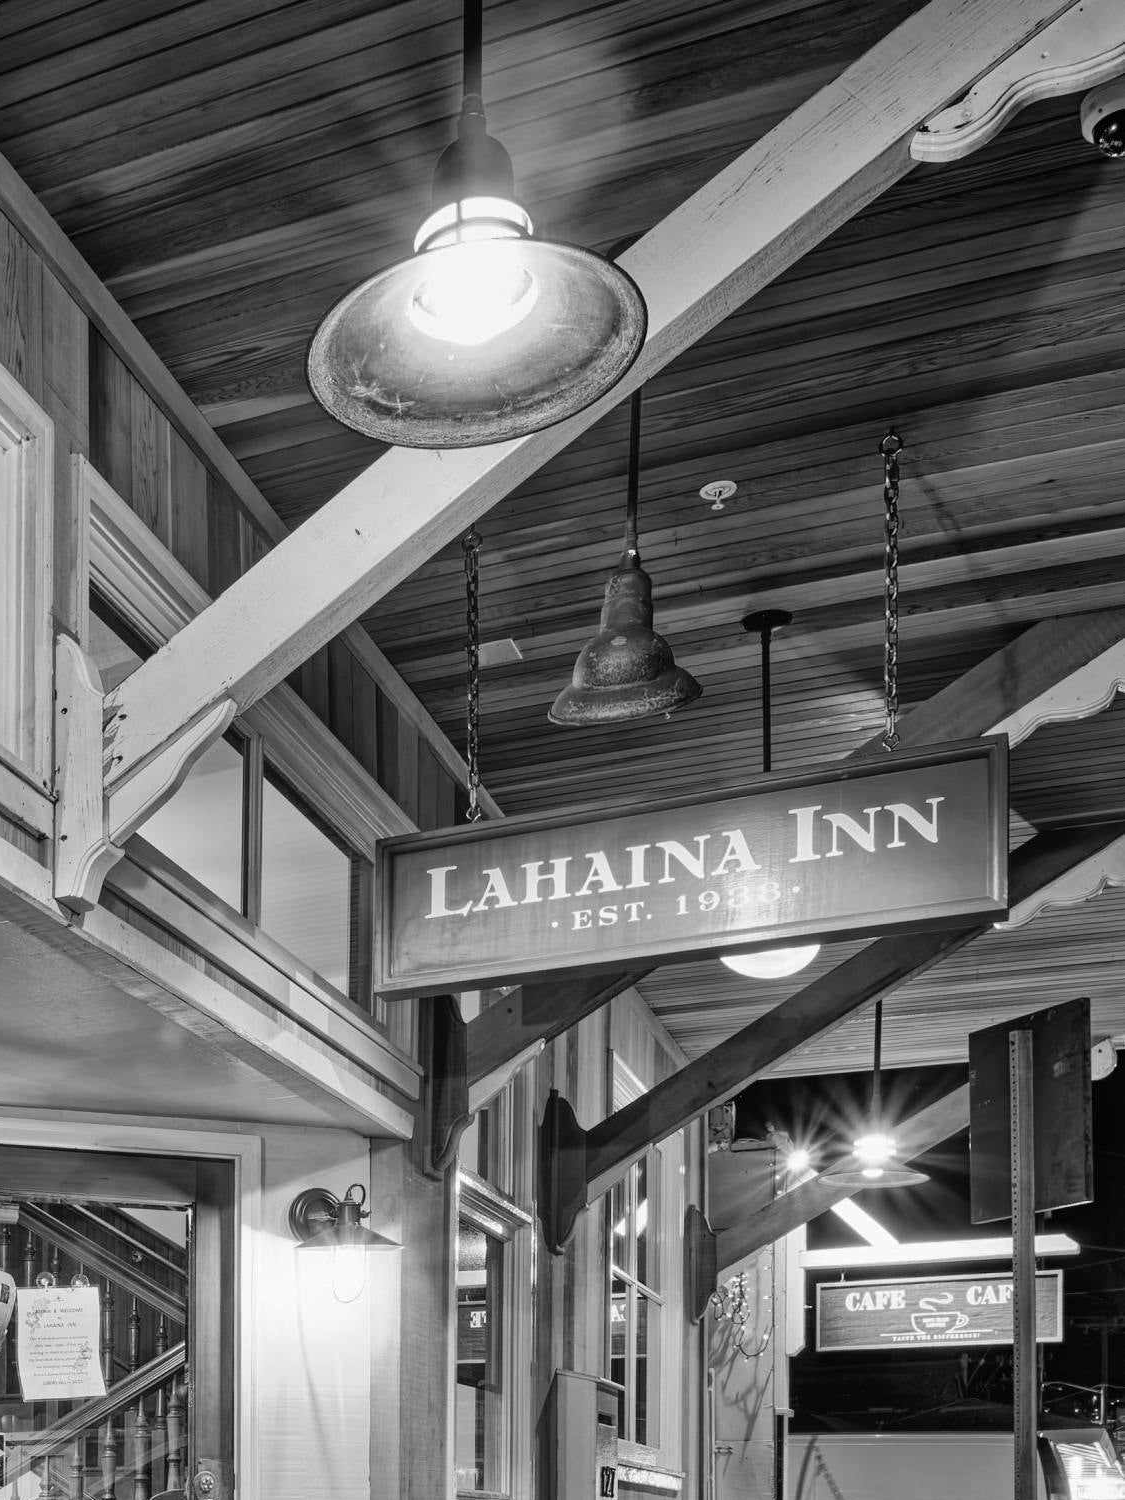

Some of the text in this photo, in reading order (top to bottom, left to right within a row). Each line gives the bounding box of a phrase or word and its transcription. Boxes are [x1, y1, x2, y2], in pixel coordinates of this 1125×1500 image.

[424, 797, 945, 919] LAHAINA INN
[571, 882, 781, 930] EST. 1938
[845, 1289, 906, 1311] CAFE
[966, 1284, 1014, 1305] CAF
